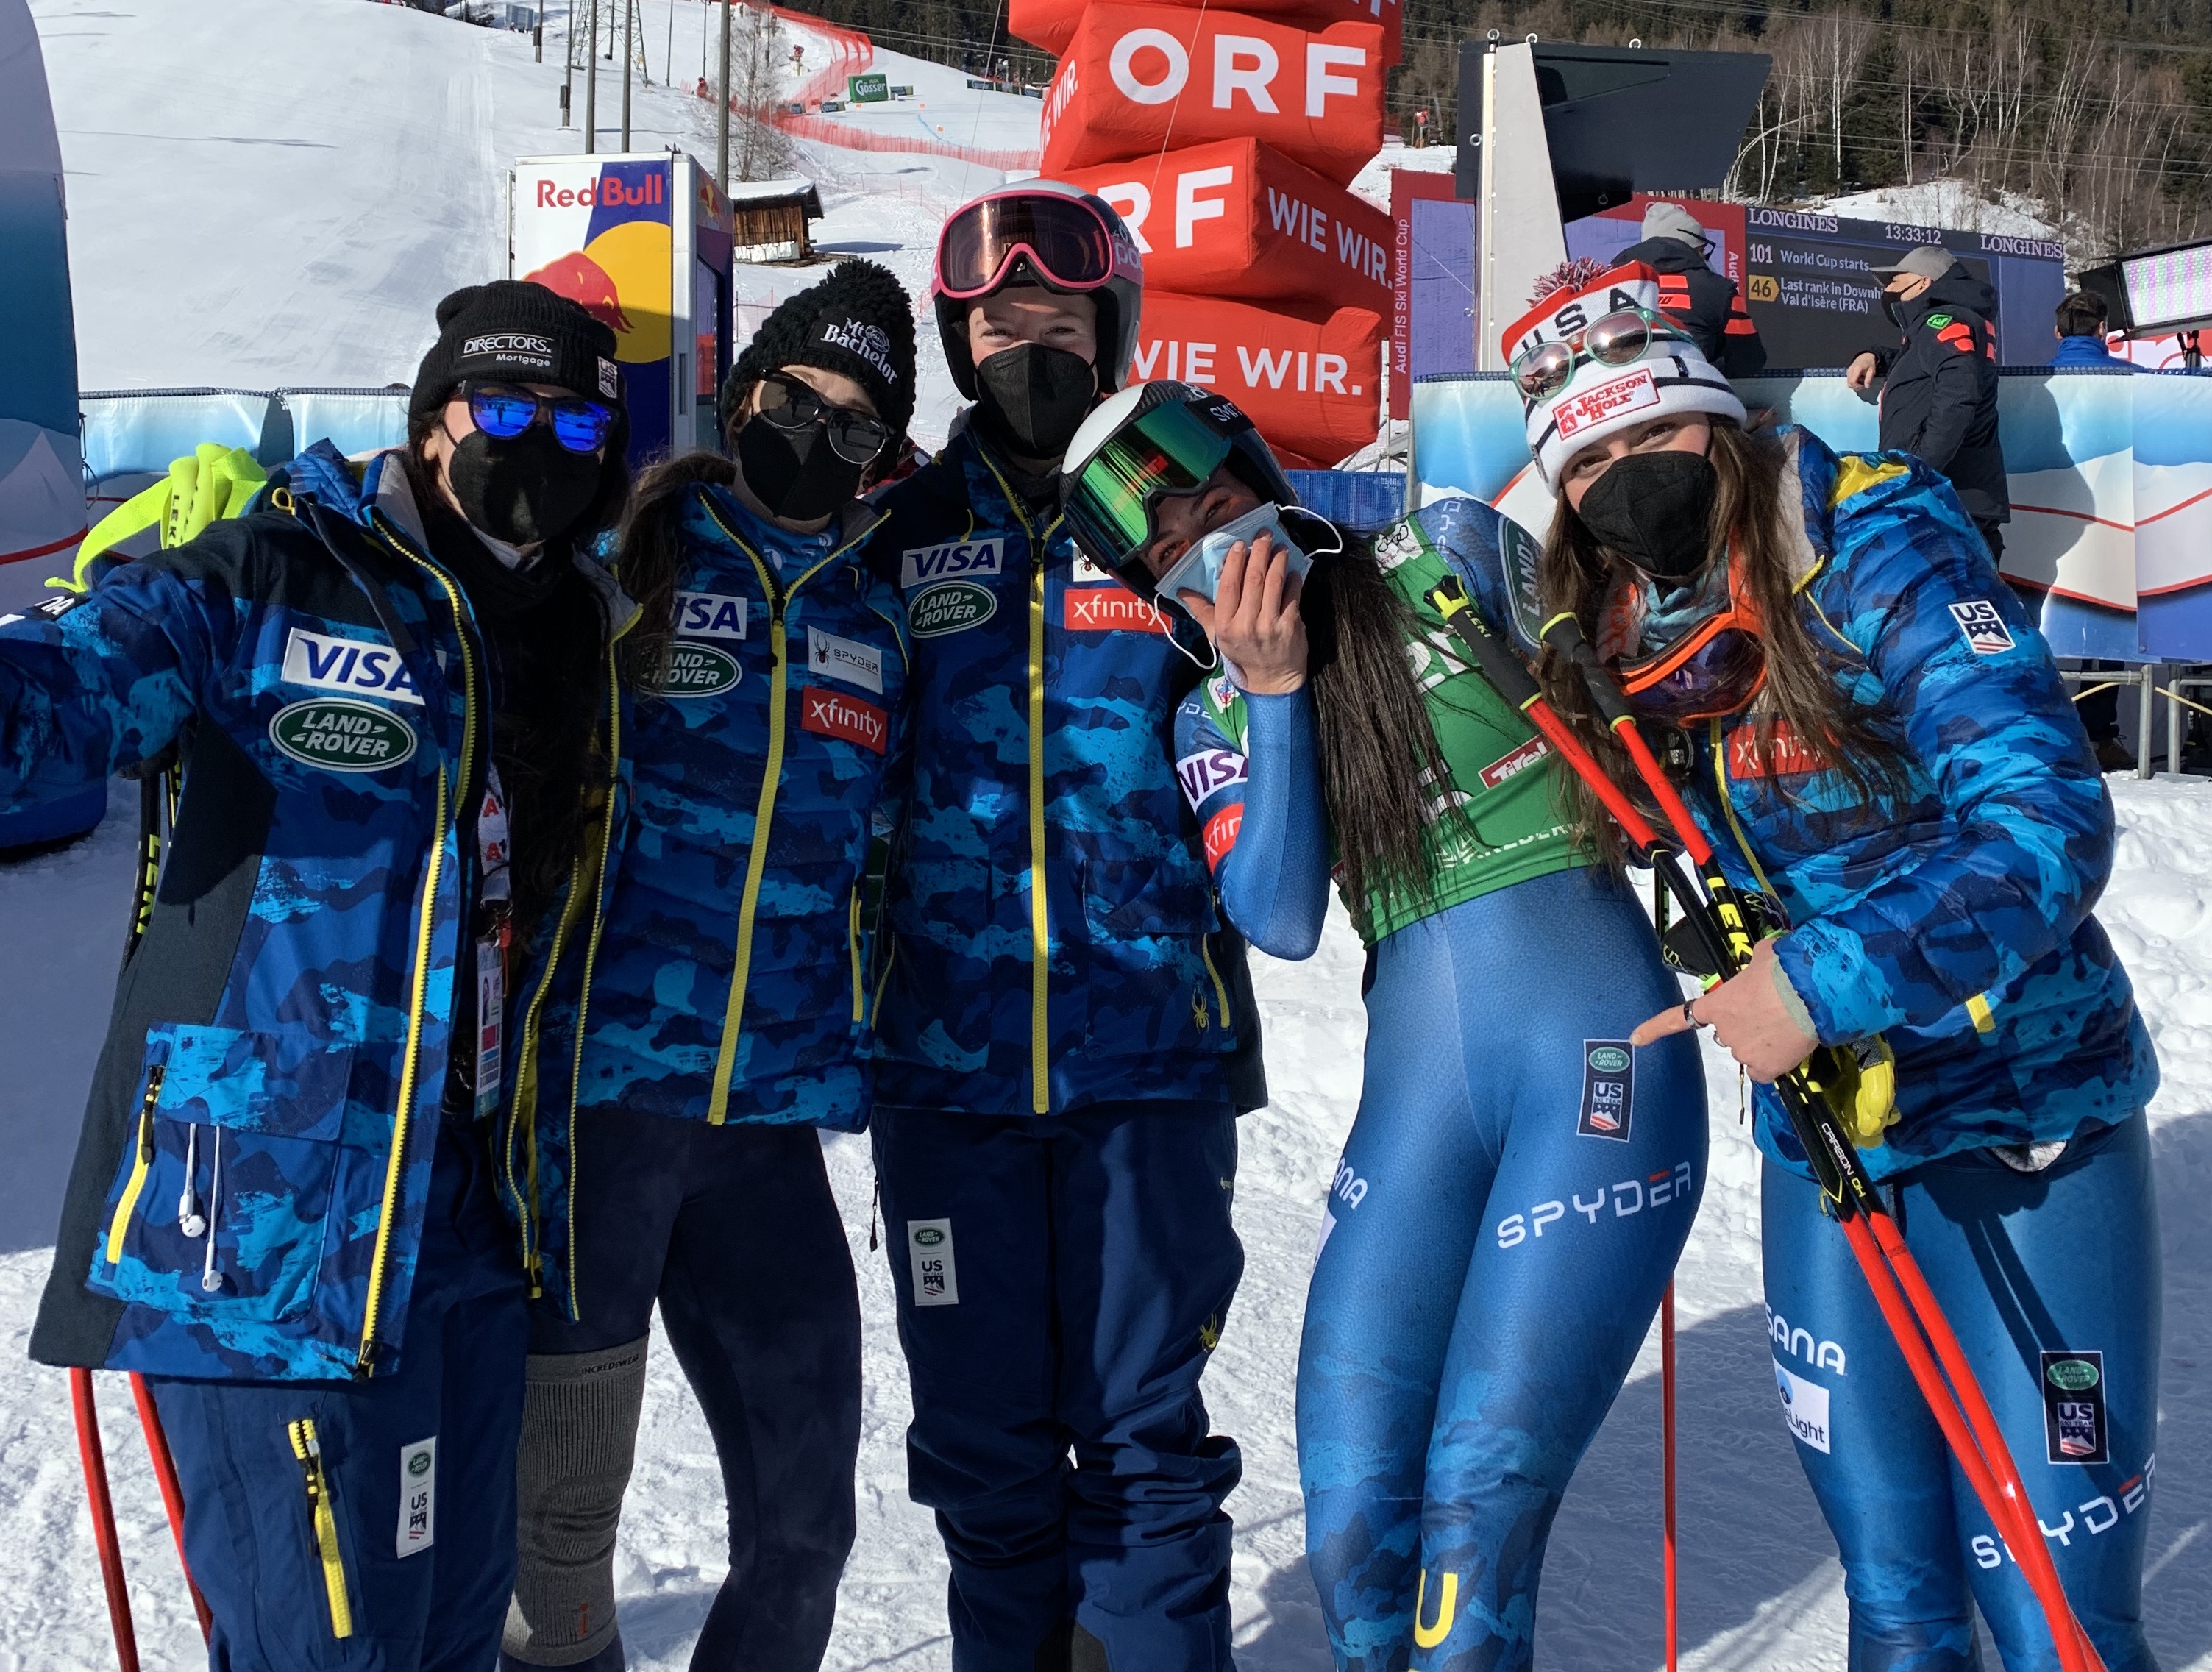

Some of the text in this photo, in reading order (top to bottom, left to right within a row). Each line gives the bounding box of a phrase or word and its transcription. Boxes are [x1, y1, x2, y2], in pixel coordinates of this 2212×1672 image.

[856, 79, 886, 96] Gösser
[1109, 28, 1366, 118] ORF
[1053, 59, 1078, 127] WIR.
[537, 174, 661, 208] Red Bull
[1749, 209, 1838, 233] LONGINES
[1886, 224, 1941, 244] 13:33:12
[1268, 188, 1393, 291] WIE WIR.
[1981, 235, 2064, 259] LONGINES
[1114, 241, 1142, 272] po
[1750, 243, 1869, 271] 101 World Cup starts
[1395, 219, 1410, 374] Audi FIS Ski World Cup
[1750, 279, 1771, 298] 46
[1780, 277, 1802, 292] Last
[1804, 280, 1829, 294] rank
[1831, 282, 1841, 296] in
[1781, 292, 1868, 315] Val d'Isère (FRA)
[842, 317, 864, 338] Mt
[1522, 288, 1641, 352] USA
[496, 353, 551, 367] Mortgage
[820, 324, 897, 384] Bachelor
[1236, 346, 1362, 396] WIR.
[1576, 375, 1648, 417] JACKSON
[907, 543, 997, 579] VISA
[1517, 543, 1541, 617] LAND
[675, 597, 742, 633] ISA
[920, 592, 962, 615] LAND
[923, 605, 978, 627] ROVER
[1954, 601, 1996, 622] US
[1465, 610, 1493, 638] LEKI
[295, 636, 423, 697] VISA
[833, 648, 879, 672] SPYDER
[302, 710, 373, 735] LAND
[811, 697, 883, 743] xfinity
[305, 733, 391, 758] ROVER
[1491, 741, 1548, 781] Tirol
[1178, 752, 1248, 802] VIS
[1595, 1083, 1622, 1099] US
[1821, 1122, 1854, 1176] CARBON
[1497, 1160, 1691, 1249] SPYDER
[922, 1260, 943, 1273] US
[2060, 1404, 2094, 1420] US
[411, 1491, 427, 1511] US
[1971, 1452, 2155, 1569] SYDER
